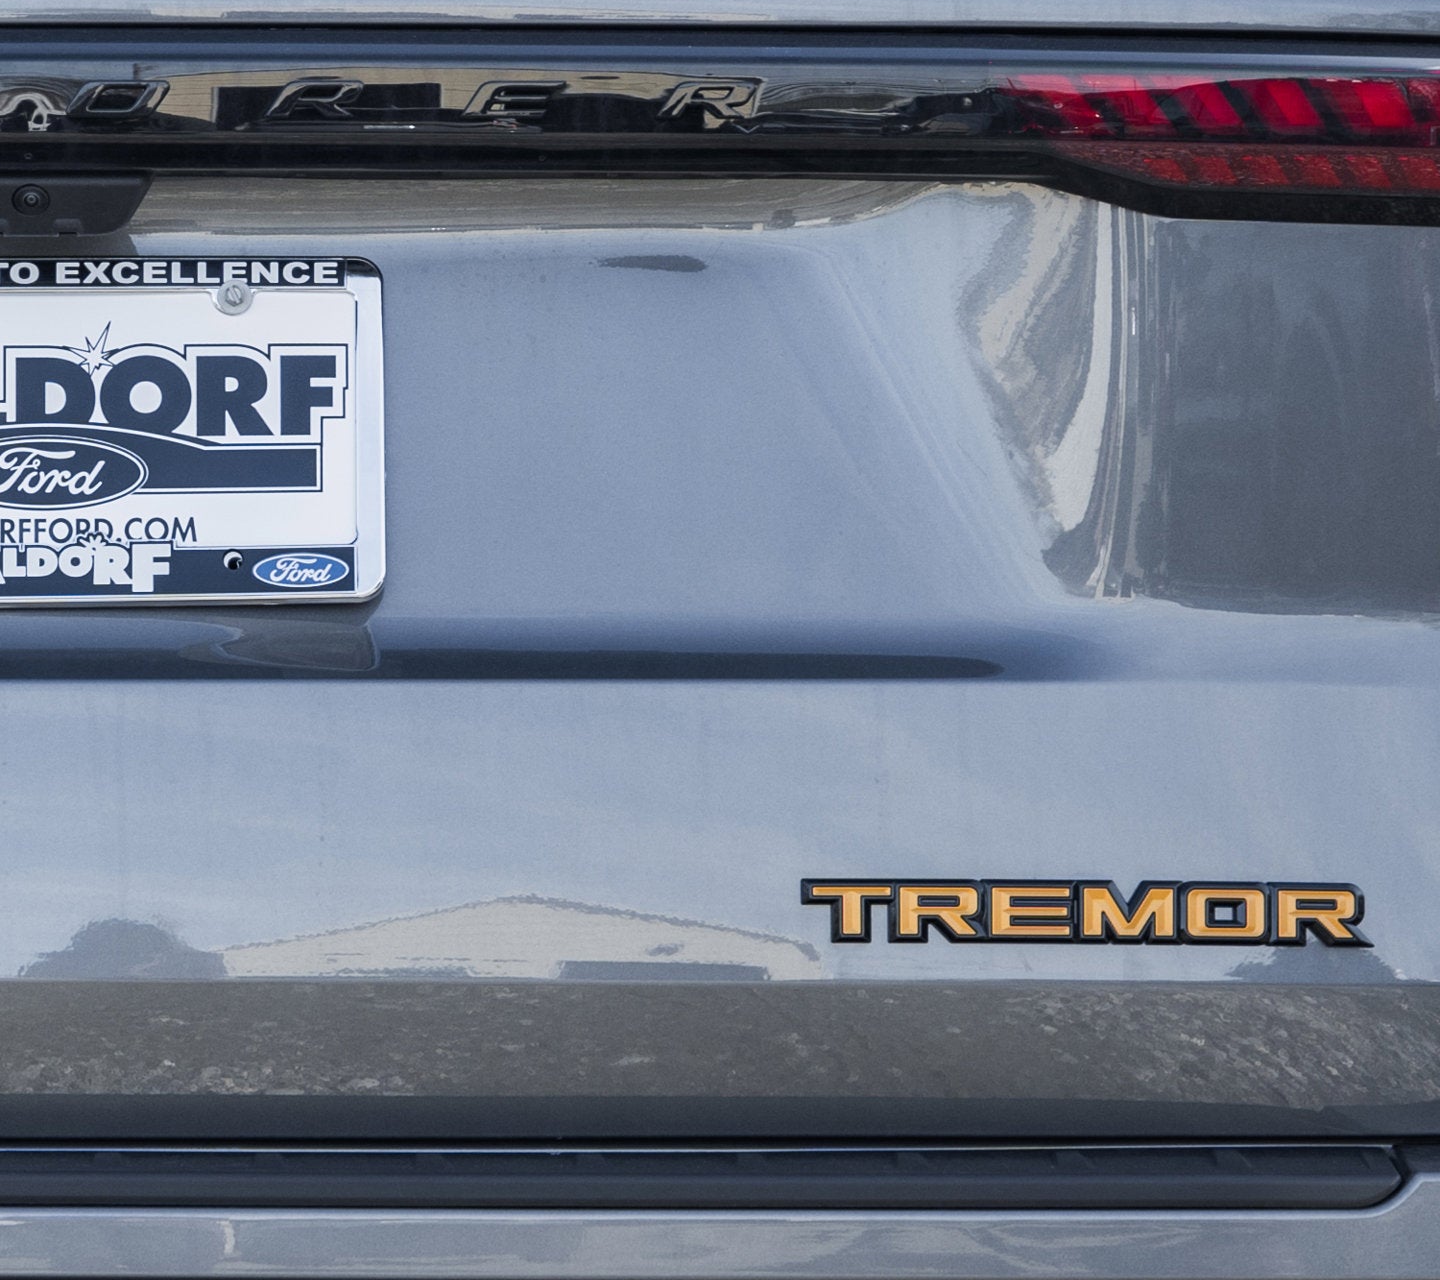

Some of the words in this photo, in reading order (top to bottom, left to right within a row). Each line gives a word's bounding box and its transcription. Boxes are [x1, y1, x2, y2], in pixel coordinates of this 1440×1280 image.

[55, 260, 339, 286] EXCELLENCE
[268, 556, 334, 583] Ford
[802, 879, 1373, 947] TREMOR
